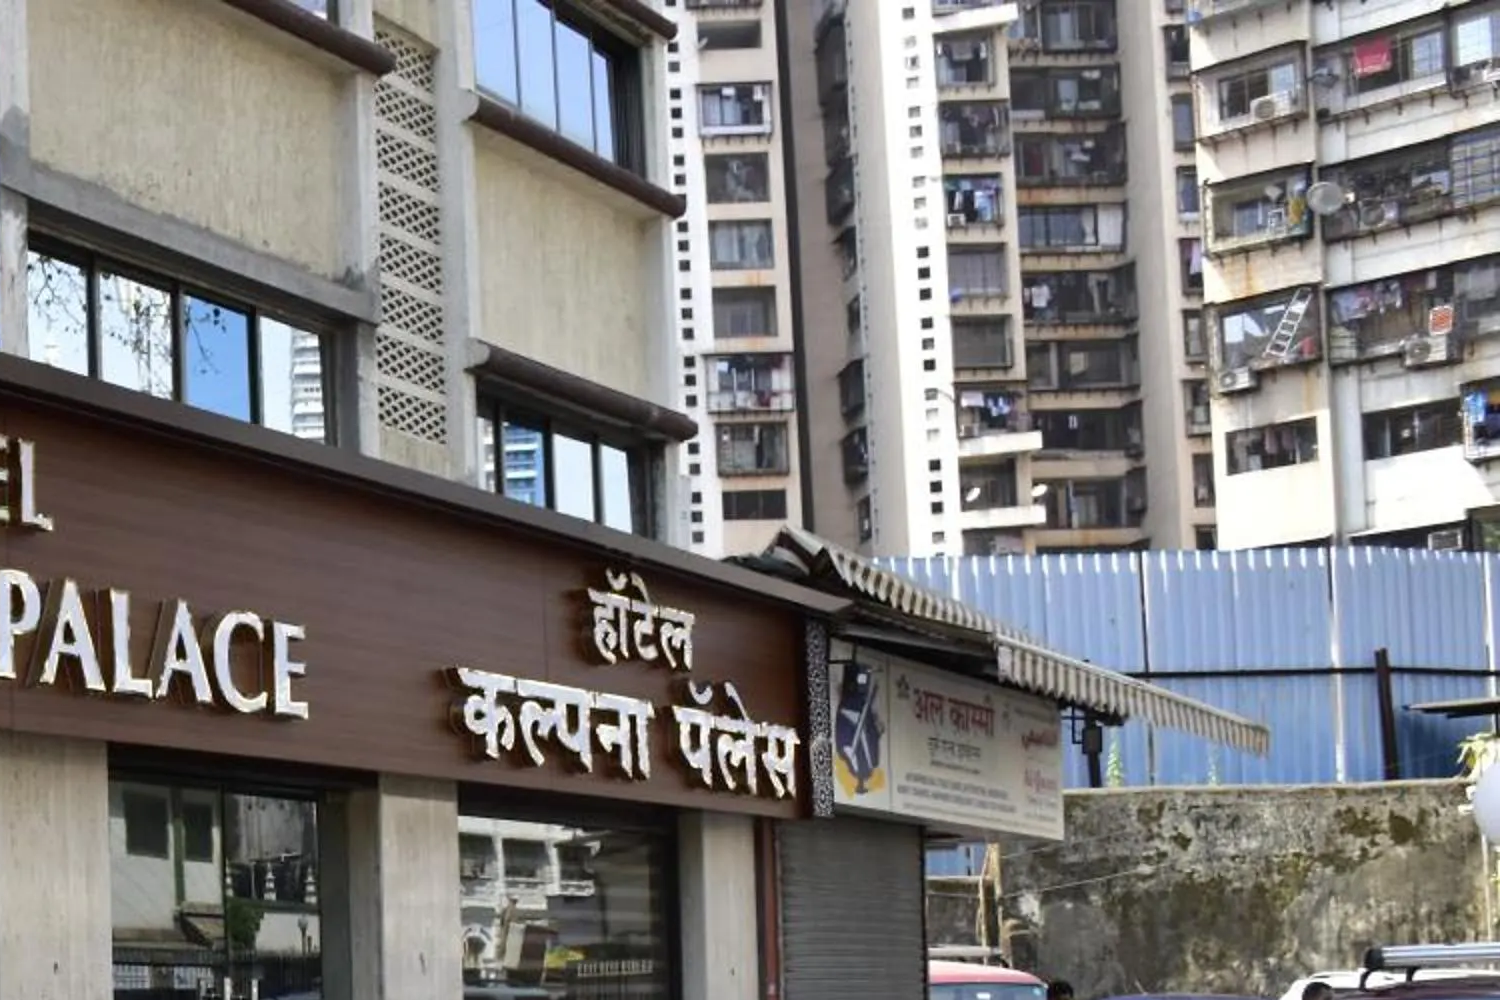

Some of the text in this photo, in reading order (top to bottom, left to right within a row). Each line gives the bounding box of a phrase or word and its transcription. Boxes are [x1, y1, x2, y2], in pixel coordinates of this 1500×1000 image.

[587, 567, 696, 671] हॉटेल
[457, 666, 801, 799] कल्पना पॅलेस
